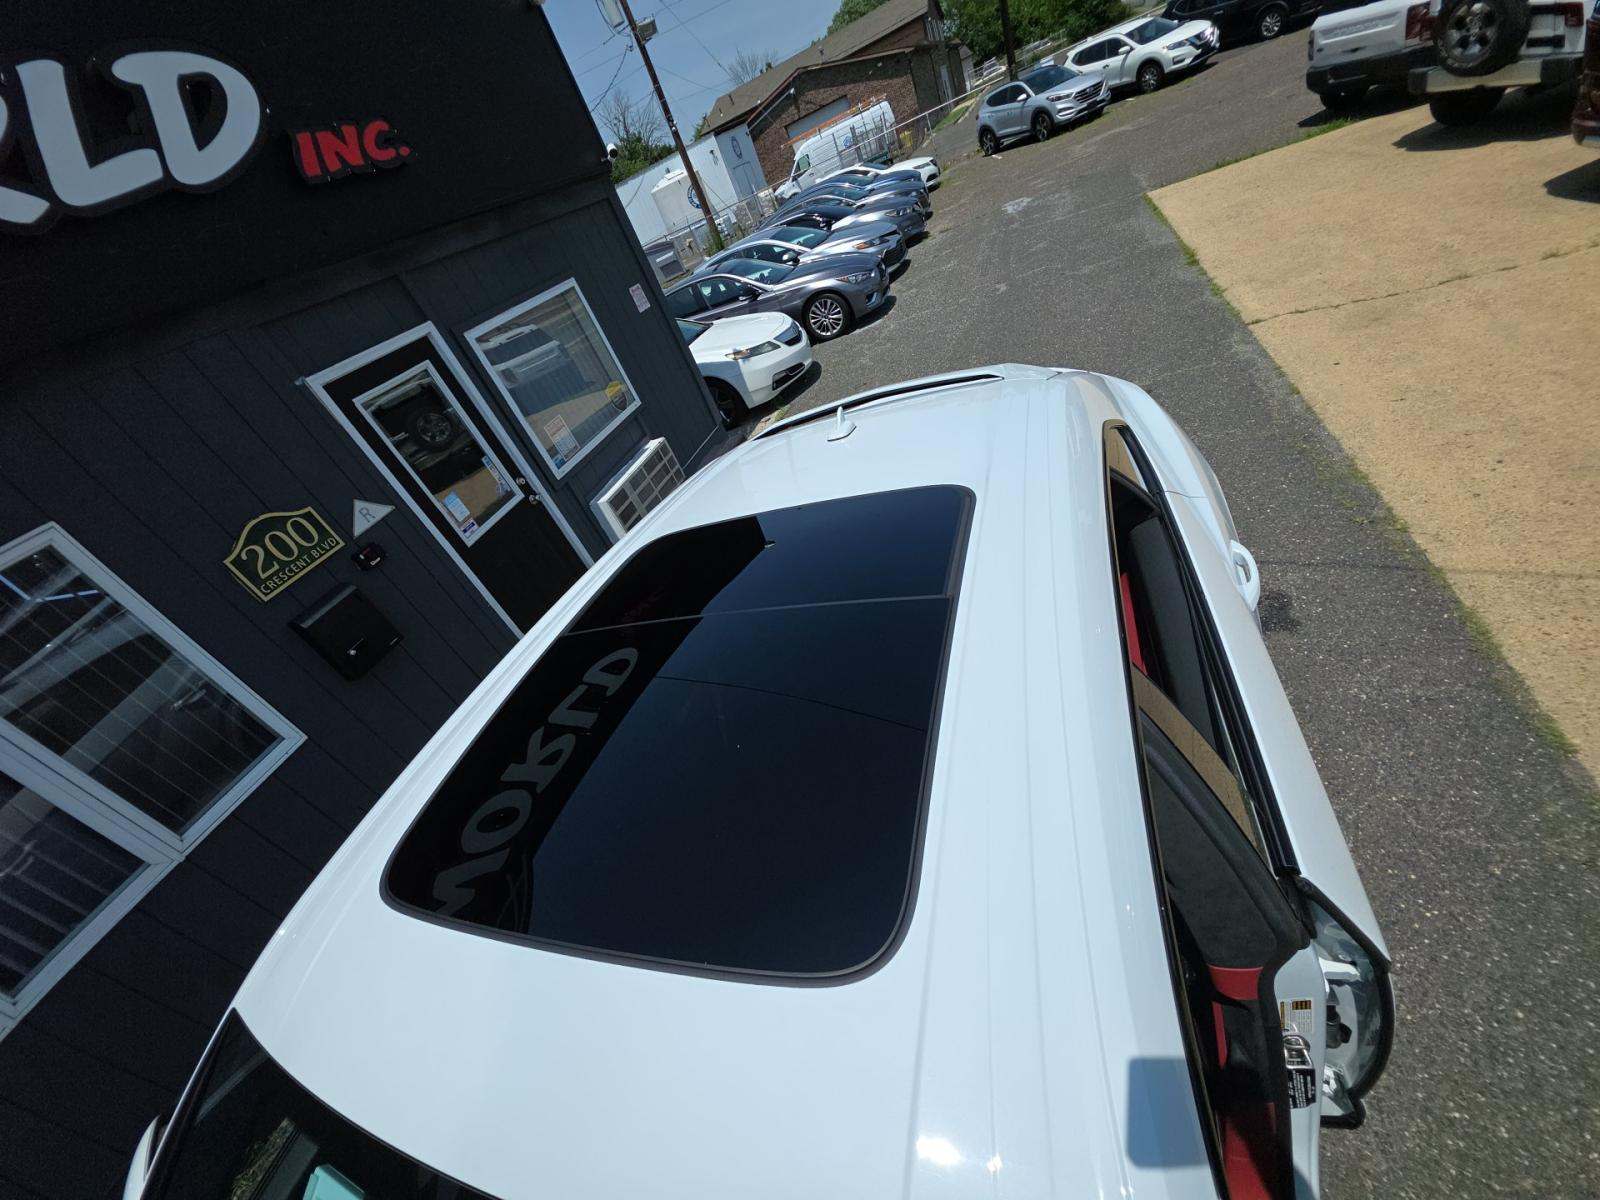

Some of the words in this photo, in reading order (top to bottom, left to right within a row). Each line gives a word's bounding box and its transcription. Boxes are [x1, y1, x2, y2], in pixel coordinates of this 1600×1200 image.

[296, 120, 411, 177] INC.
[359, 507, 376, 523] R
[240, 517, 319, 579] 200
[260, 555, 312, 593] CRESCENT
[311, 537, 337, 558] BLVD
